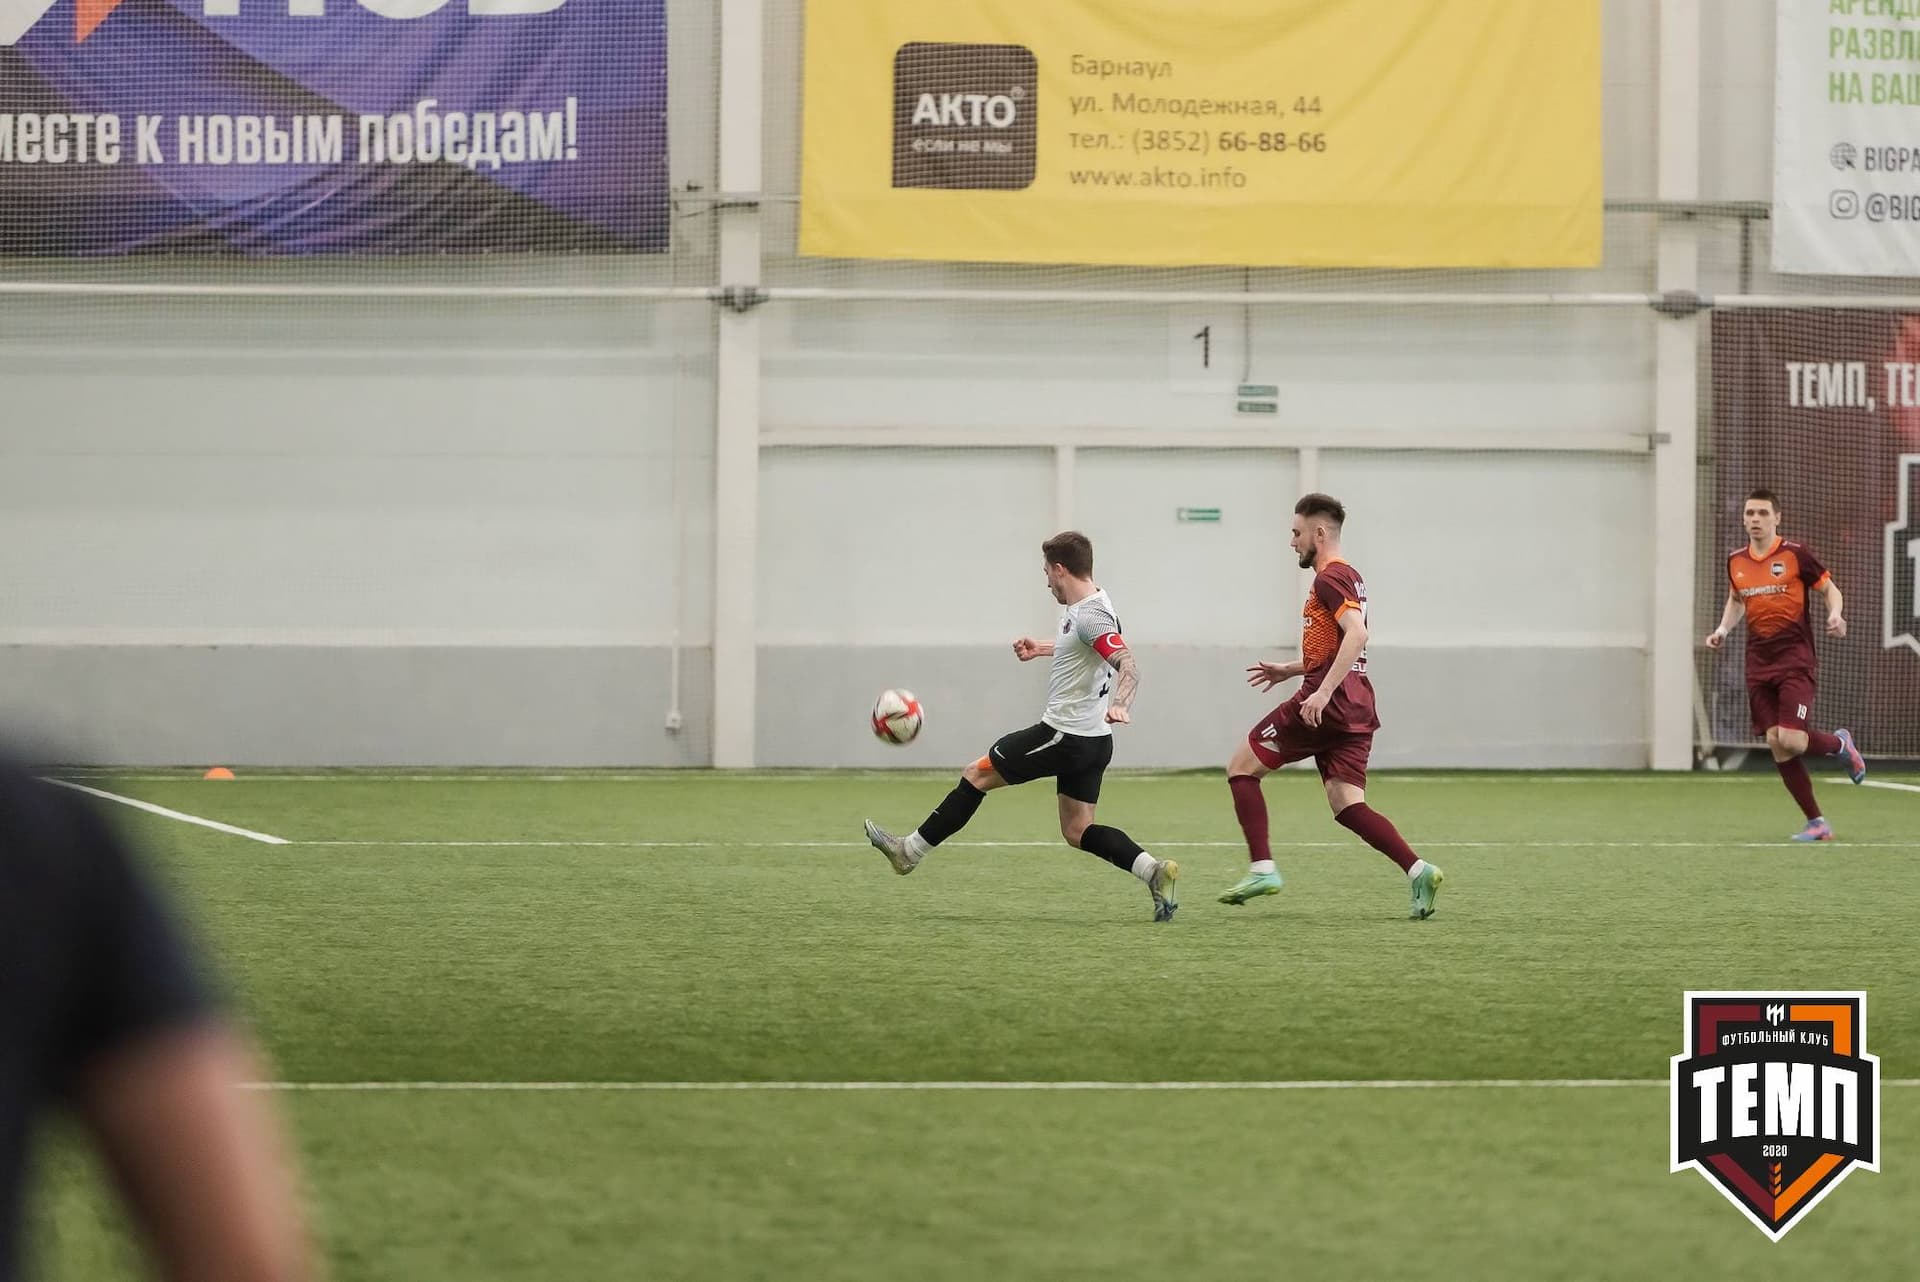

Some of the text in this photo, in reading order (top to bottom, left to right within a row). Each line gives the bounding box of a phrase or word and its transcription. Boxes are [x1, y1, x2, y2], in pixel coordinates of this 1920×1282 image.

[1829, 26, 1920, 60] РАЗВЛ
[1071, 54, 1172, 80] Барнаул
[1829, 71, 1863, 103] НА
[1069, 93, 1322, 119] ул. Молодежная, 44
[178, 115, 343, 164] новым
[359, 96, 578, 170] победам!
[1132, 128, 1210, 156] (3852)
[1218, 131, 1326, 153] 66-88-66
[1069, 166, 1247, 188] www.akto.info
[1193, 325, 1210, 369] 1
[1785, 361, 1920, 412] ТЕМП, ТЕ
[1797, 703, 1808, 720] 19
